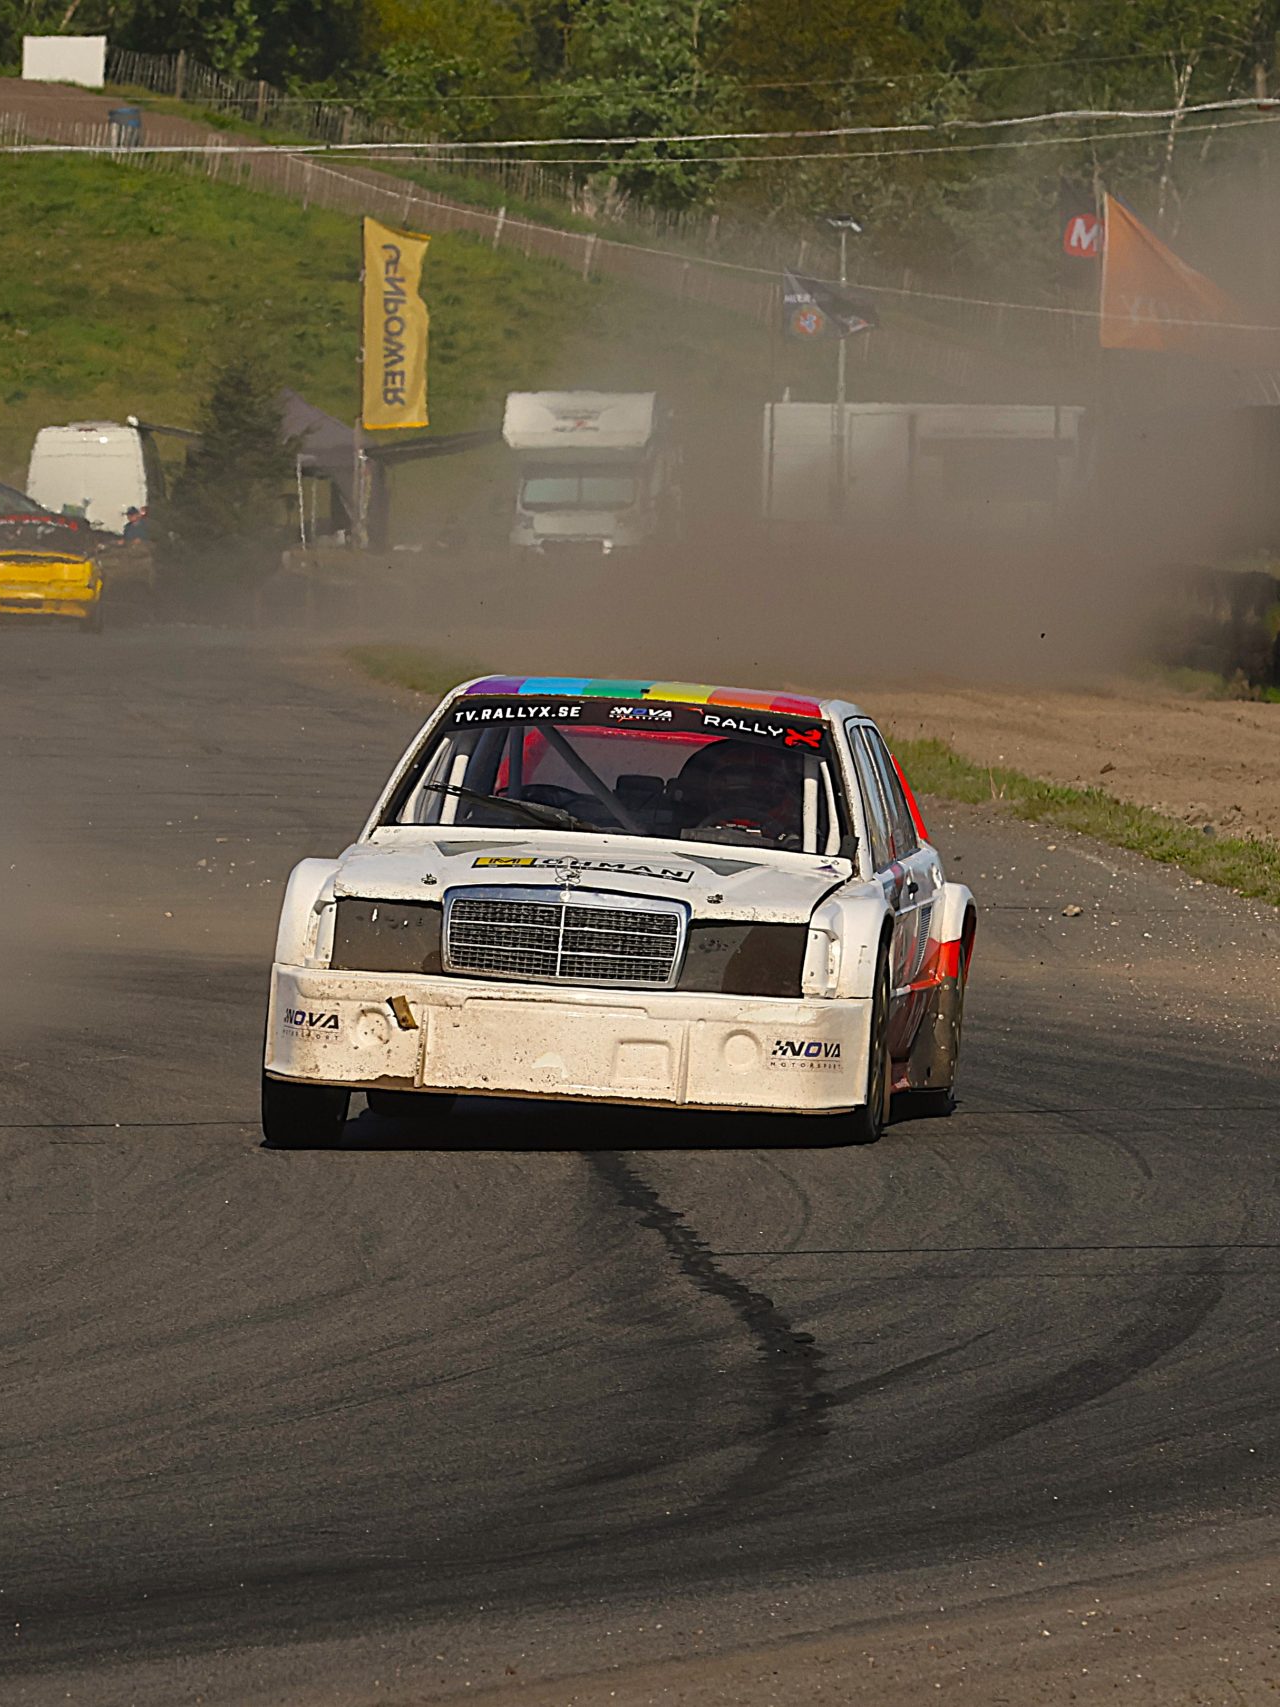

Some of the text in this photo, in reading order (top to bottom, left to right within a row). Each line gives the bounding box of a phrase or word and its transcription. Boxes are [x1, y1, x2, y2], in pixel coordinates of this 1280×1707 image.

[454, 705, 582, 723] TV.RALLYX.SE
[283, 1007, 339, 1030] NOVA
[772, 1040, 841, 1058] NOVA
